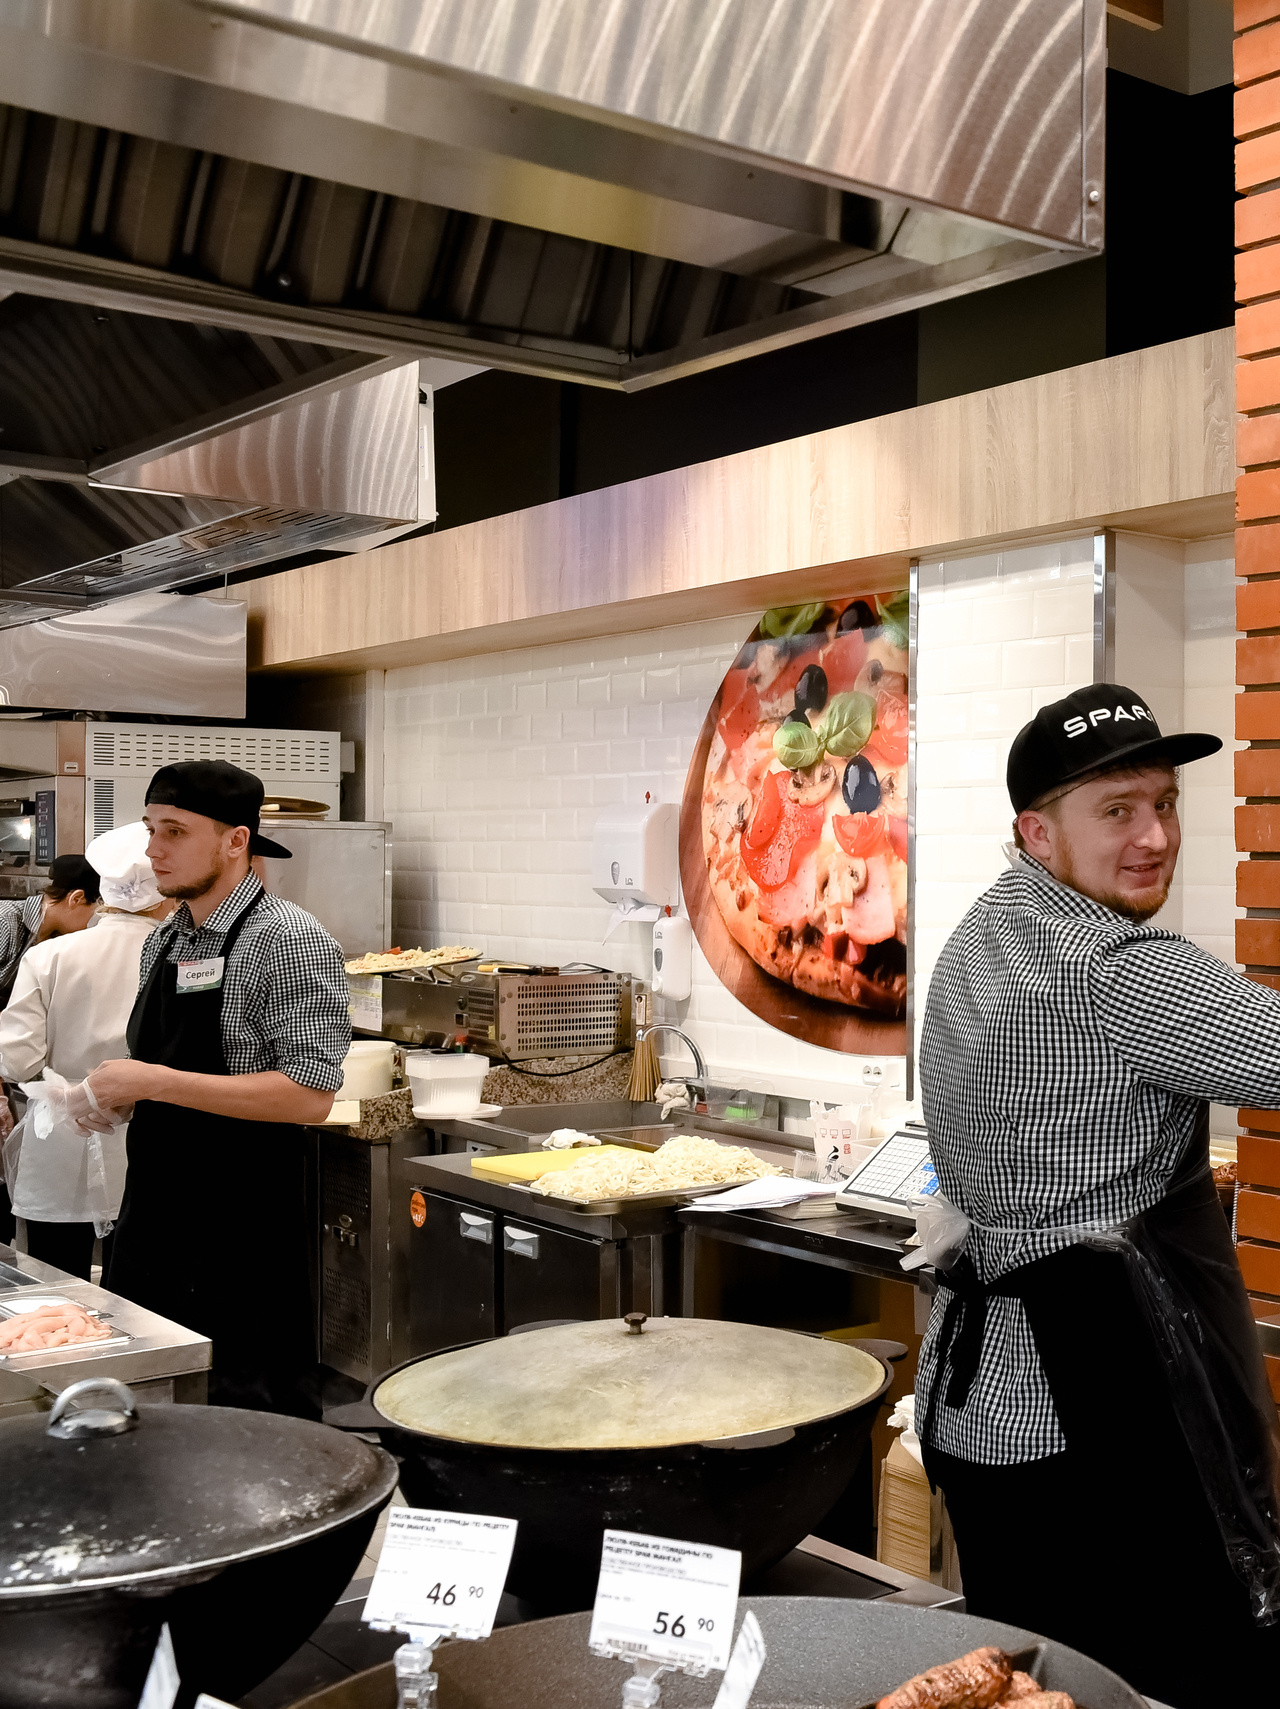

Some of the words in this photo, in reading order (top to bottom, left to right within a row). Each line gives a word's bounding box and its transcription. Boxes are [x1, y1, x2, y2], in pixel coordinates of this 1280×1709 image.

[1063, 705, 1150, 738] SPAR
[186, 968, 215, 979] Сергей
[426, 1582, 457, 1606] 46
[469, 1586, 484, 1599] 90
[653, 1611, 686, 1638] 56
[698, 1618, 715, 1632] 90
